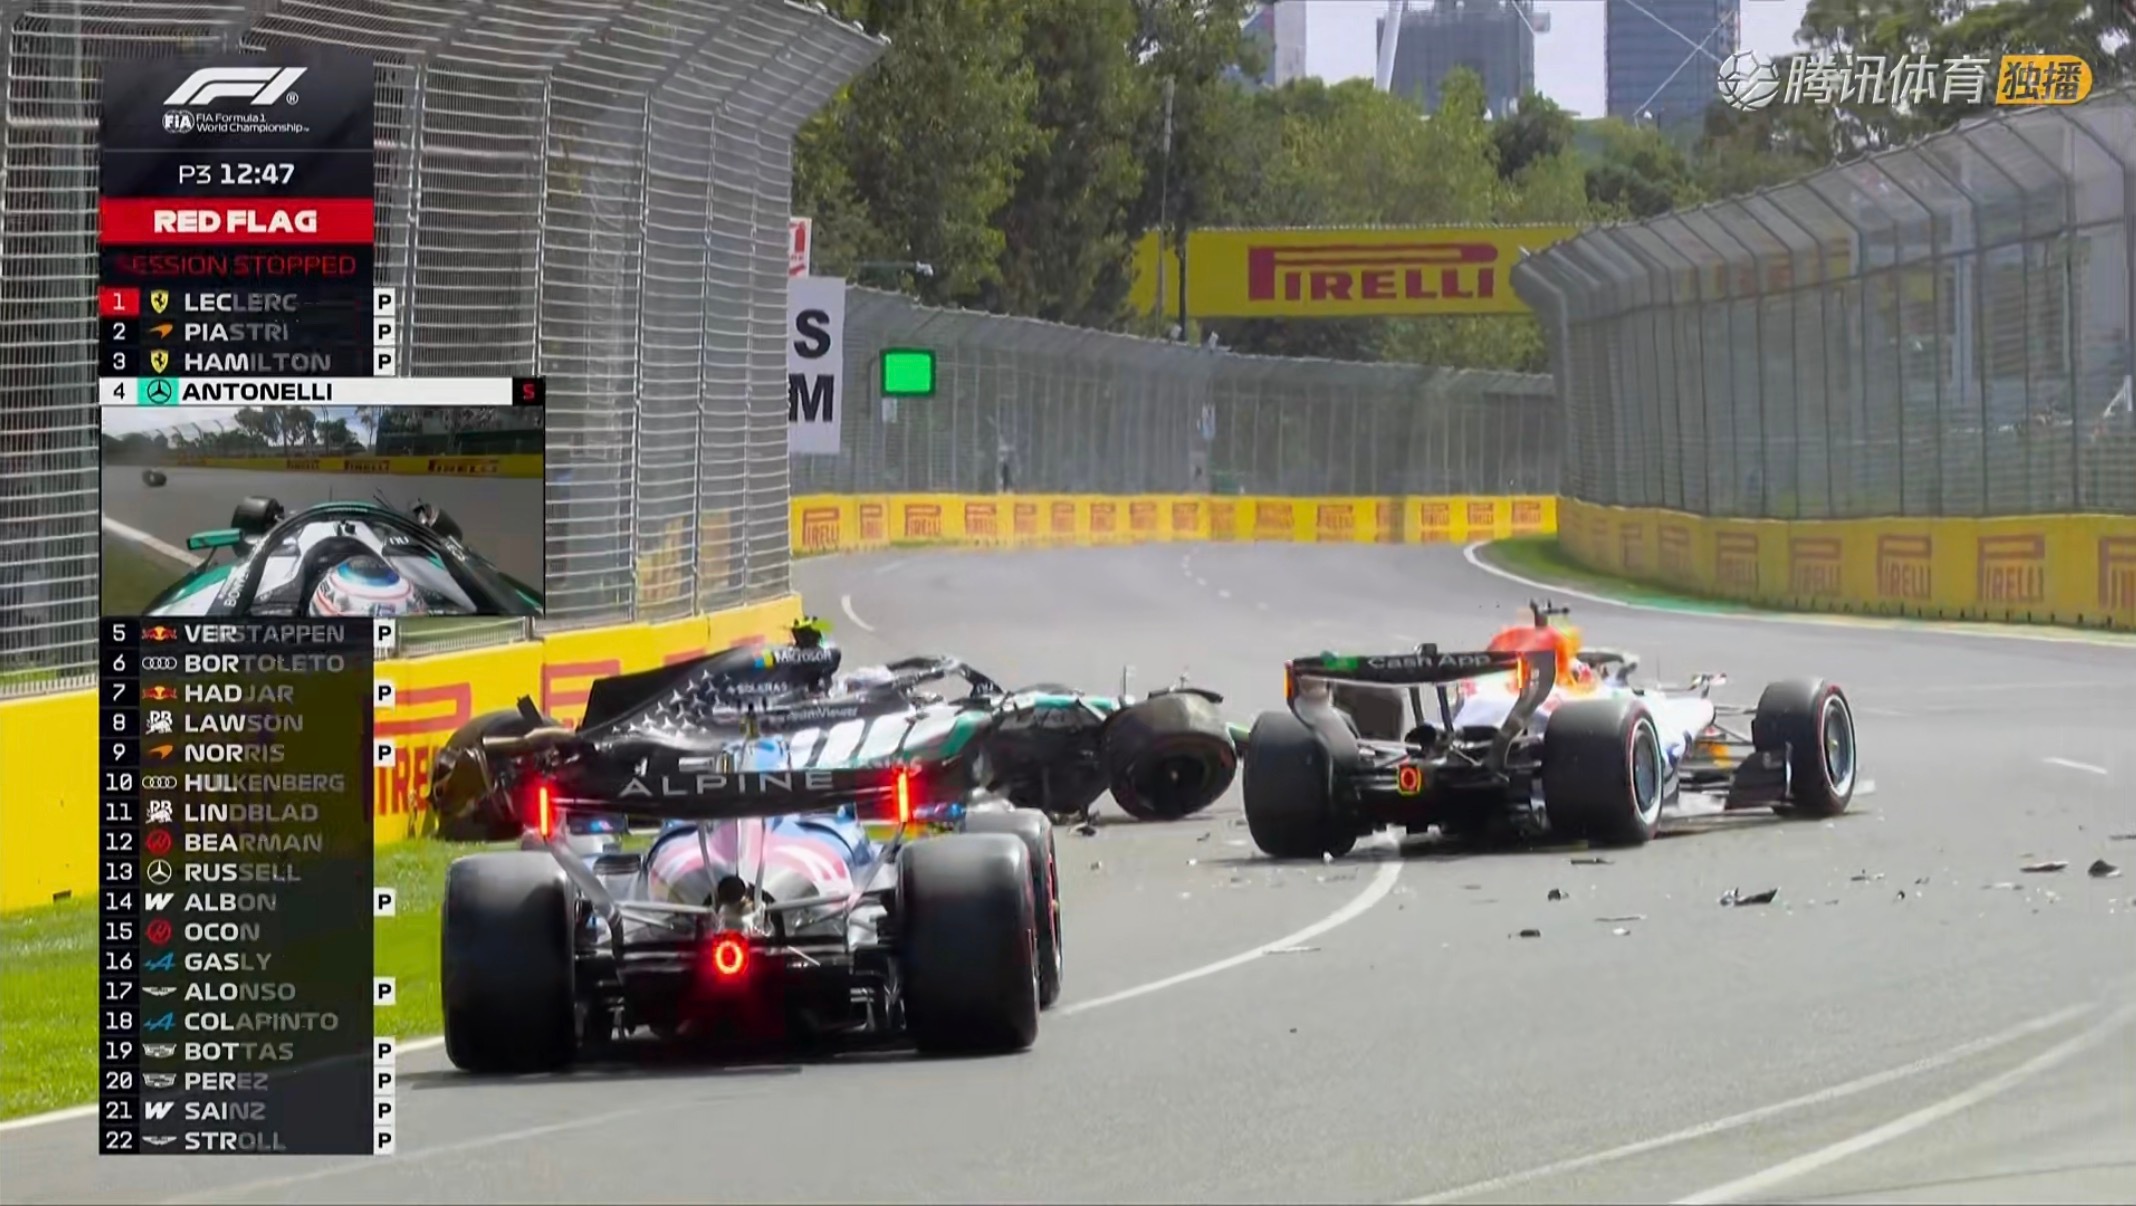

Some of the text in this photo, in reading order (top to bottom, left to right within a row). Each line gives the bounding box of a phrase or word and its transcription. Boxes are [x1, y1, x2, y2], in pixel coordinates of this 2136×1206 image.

[1248, 243, 1498, 300] PIRELLI
[794, 309, 832, 359] S
[1368, 654, 1491, 670] Cash App
[619, 771, 833, 798] ALPINE
